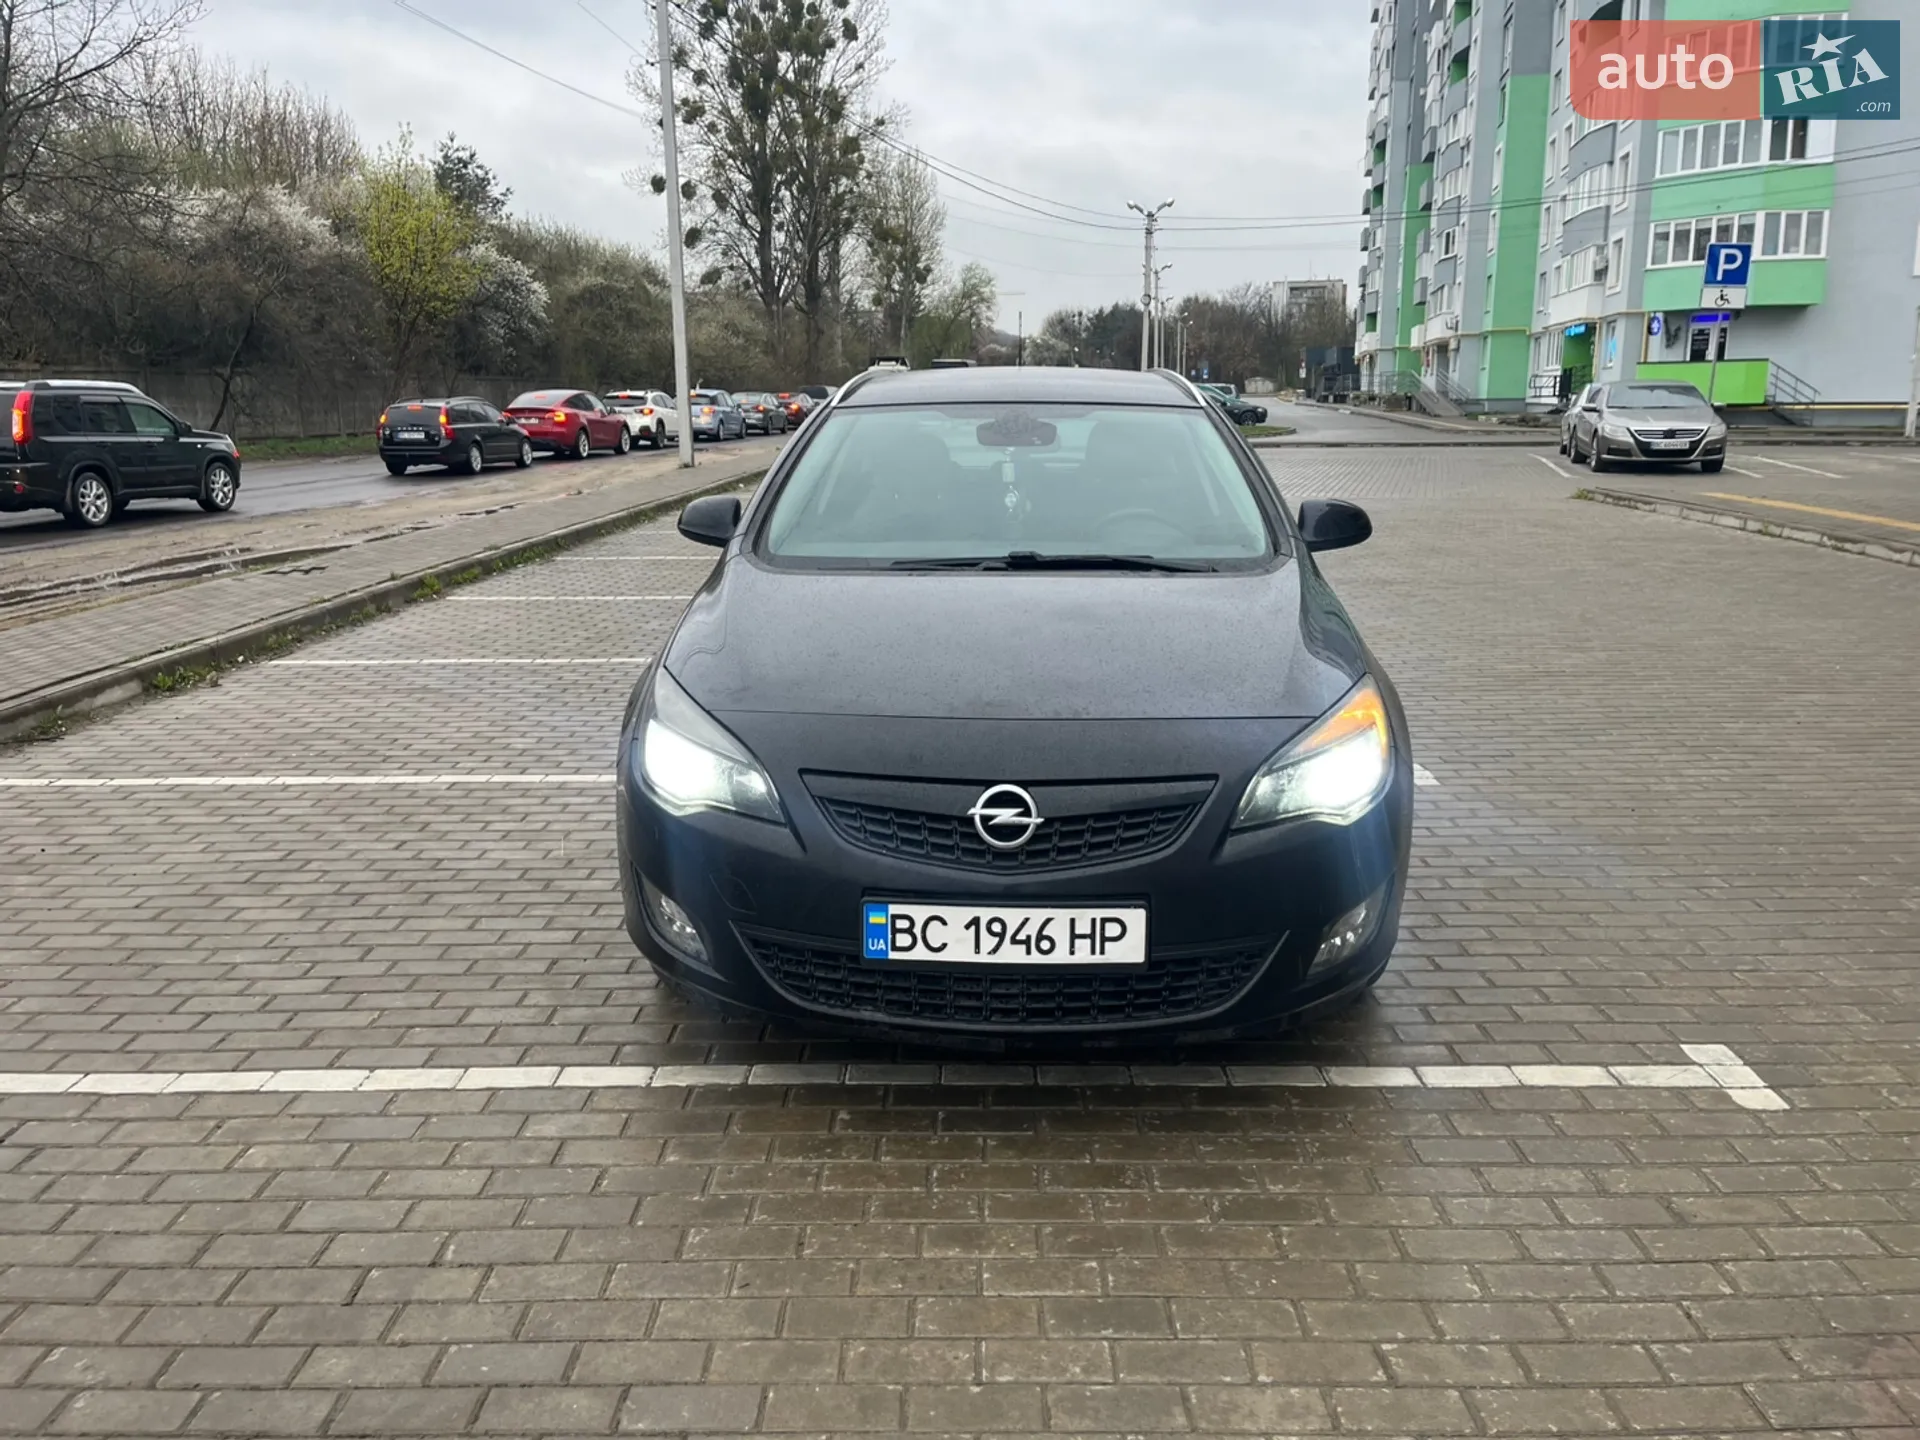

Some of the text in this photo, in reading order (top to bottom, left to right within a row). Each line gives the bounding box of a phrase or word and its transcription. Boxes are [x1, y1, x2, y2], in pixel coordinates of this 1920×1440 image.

[1716, 248, 1743, 281] P
[868, 937, 887, 951] UA
[889, 913, 1128, 956] BC 1946 HP
